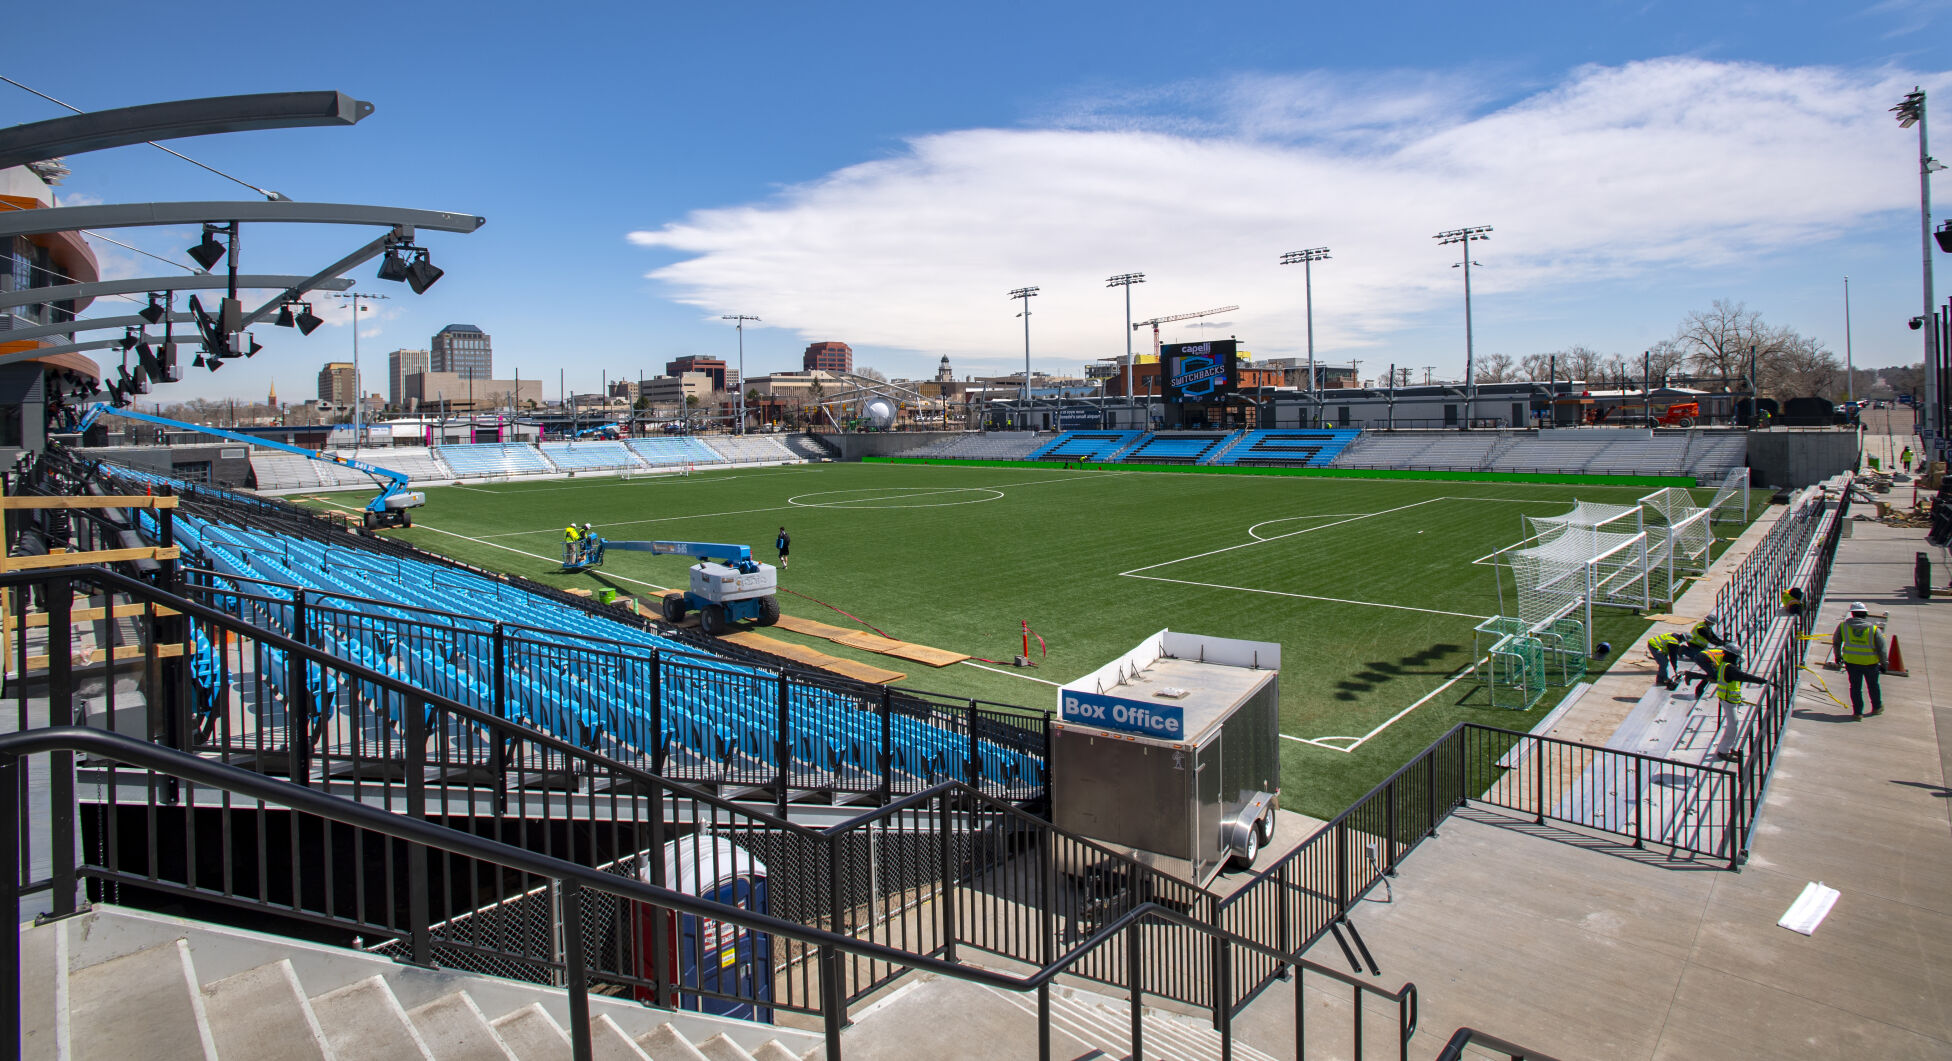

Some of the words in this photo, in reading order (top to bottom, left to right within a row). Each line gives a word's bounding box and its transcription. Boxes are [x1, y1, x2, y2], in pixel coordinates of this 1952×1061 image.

[1182, 342, 1211, 355] capelli
[1171, 365, 1225, 387] SWITCHBACKS
[1065, 697, 1106, 720] Box
[1112, 704, 1179, 732] Office
